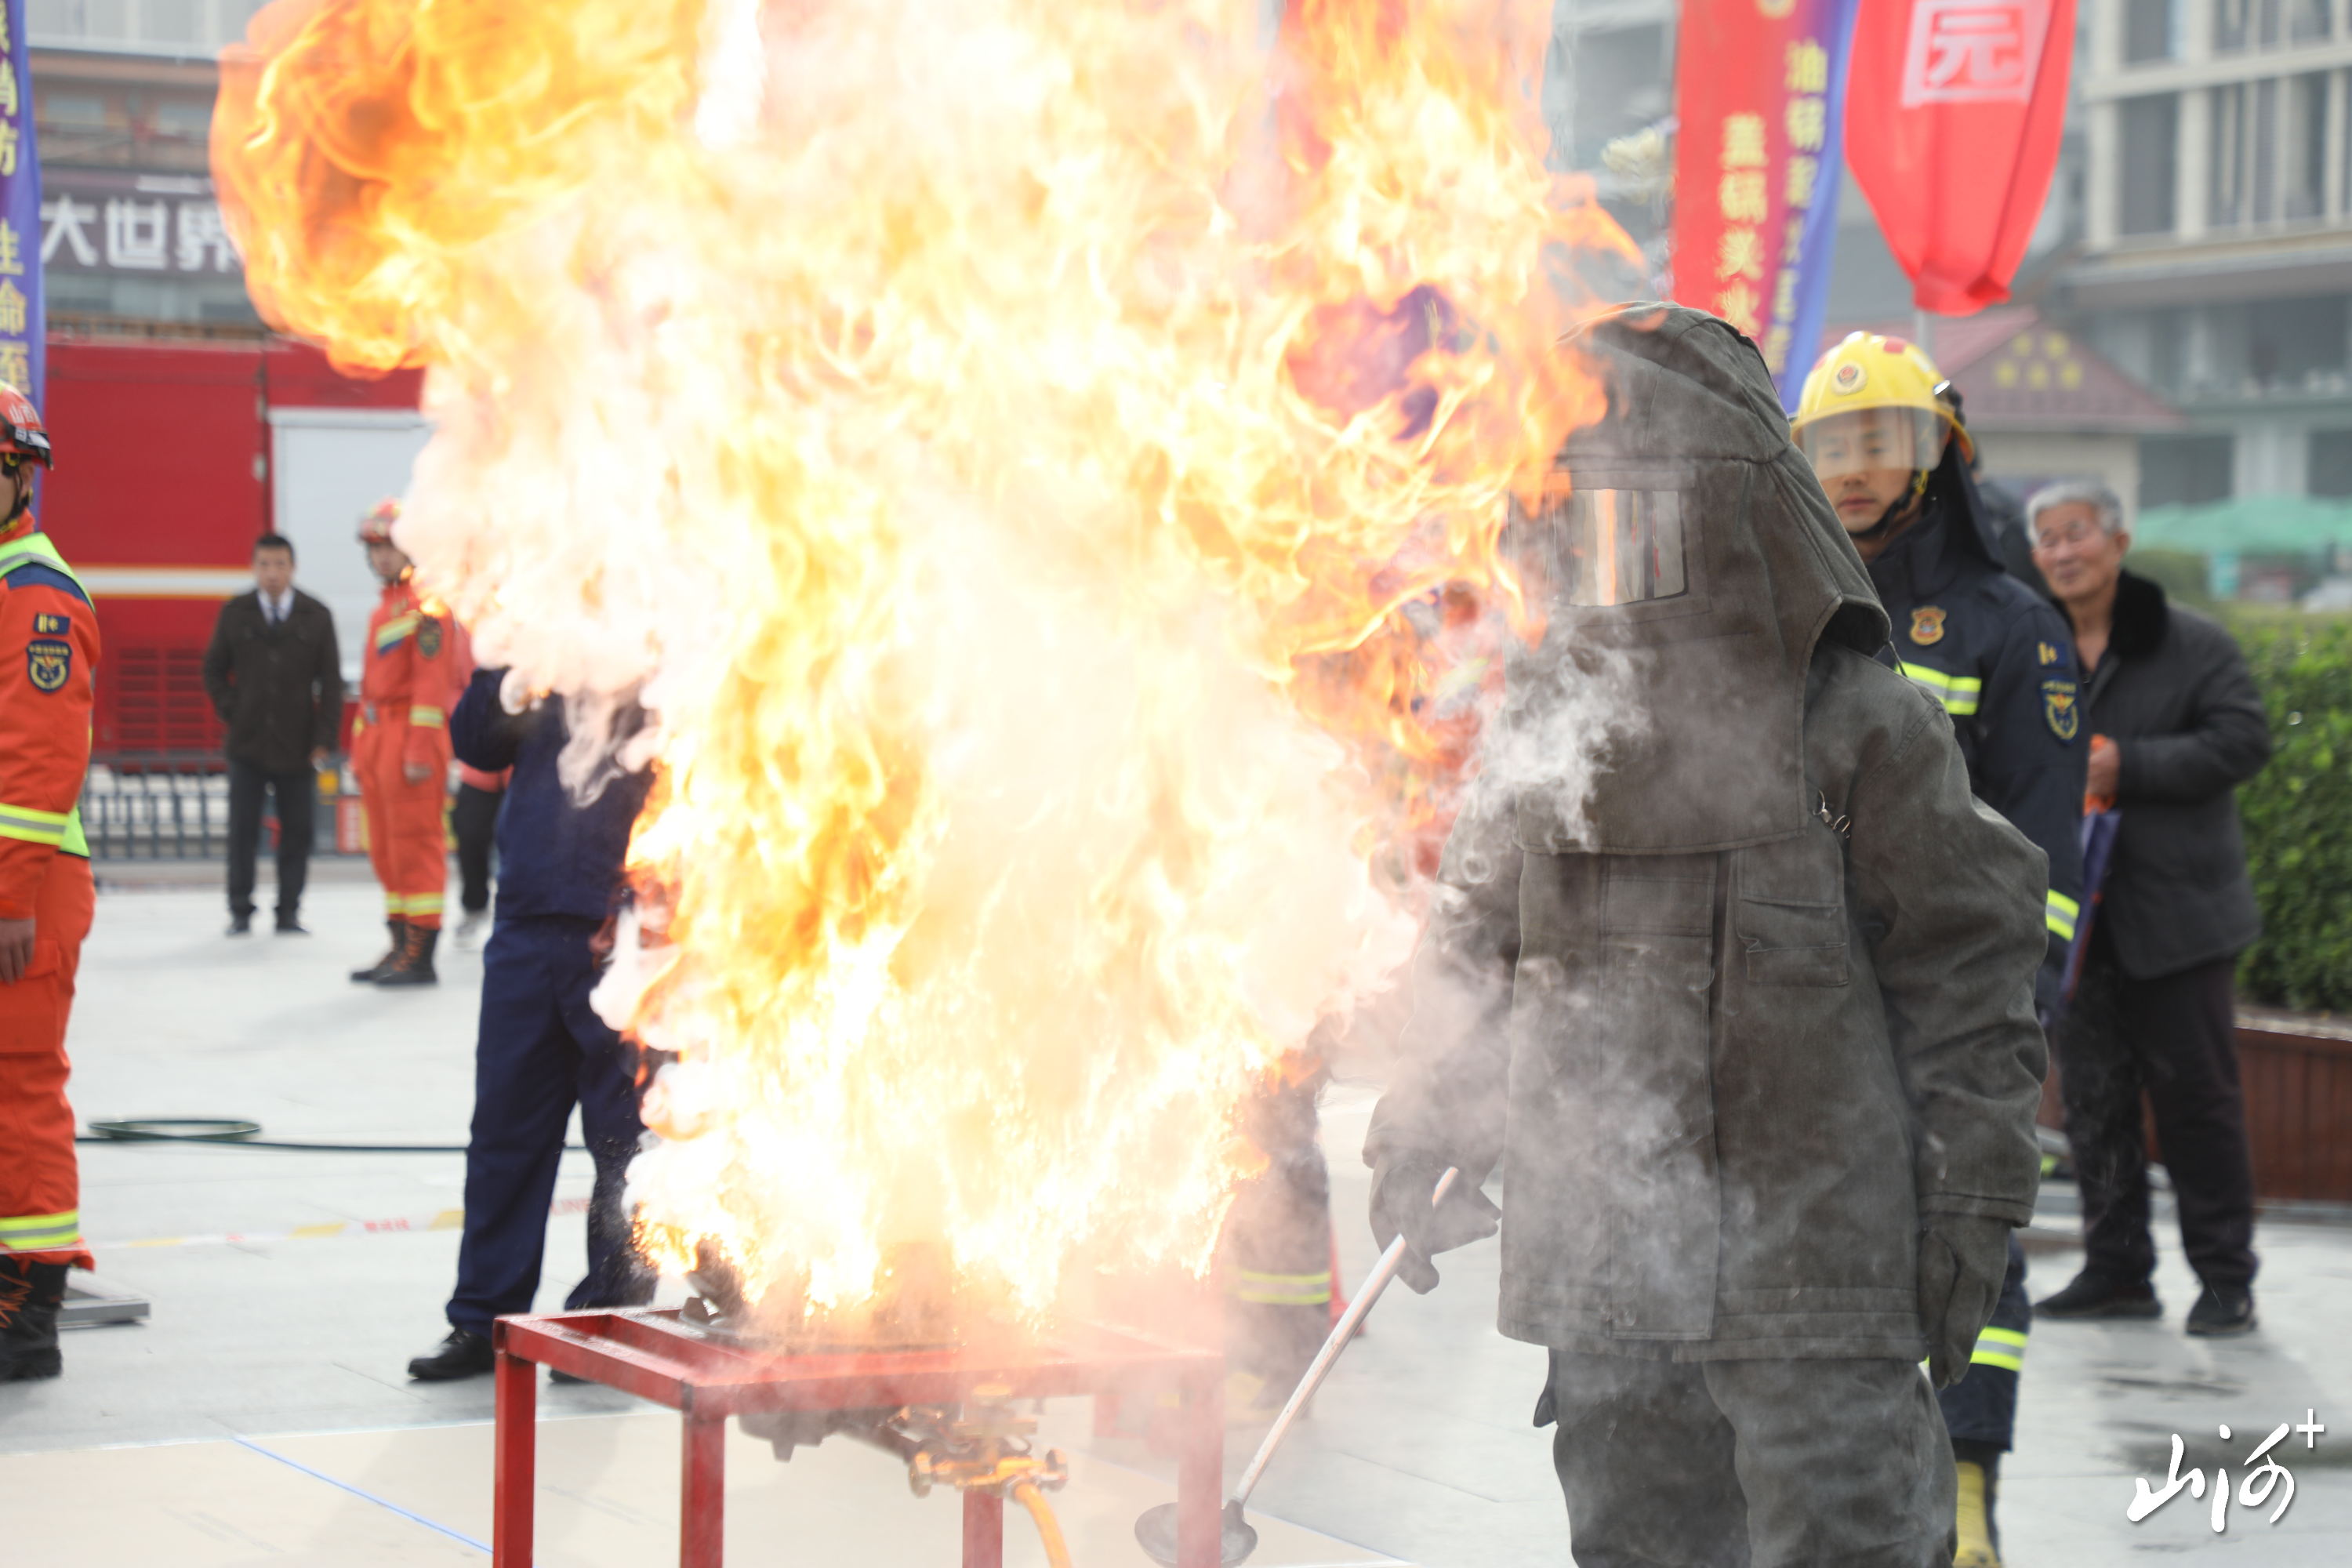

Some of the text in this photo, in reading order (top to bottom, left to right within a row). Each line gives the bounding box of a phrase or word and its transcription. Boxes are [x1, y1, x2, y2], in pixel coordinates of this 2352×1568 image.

[1900, 0, 2048, 108] 园
[39, 194, 240, 272] 大世界
